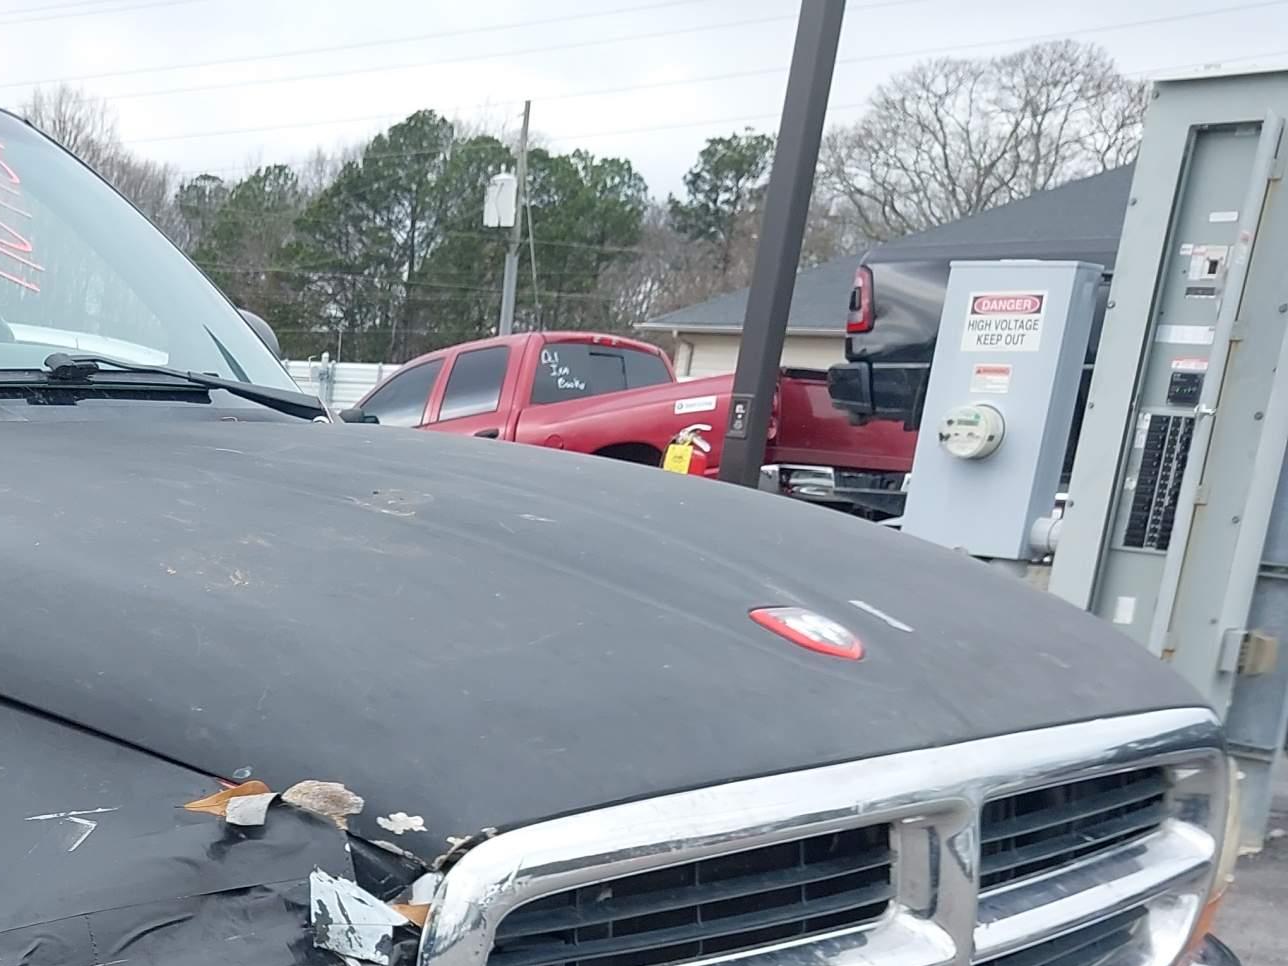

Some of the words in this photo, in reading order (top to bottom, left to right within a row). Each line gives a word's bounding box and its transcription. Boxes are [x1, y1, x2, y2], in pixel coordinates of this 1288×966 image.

[981, 299, 1032, 311] DANGER
[967, 319, 992, 331] HIGH
[995, 319, 1040, 331] VOLTAGE
[976, 333, 1003, 345] KEEP
[1004, 333, 1026, 345] OUT
